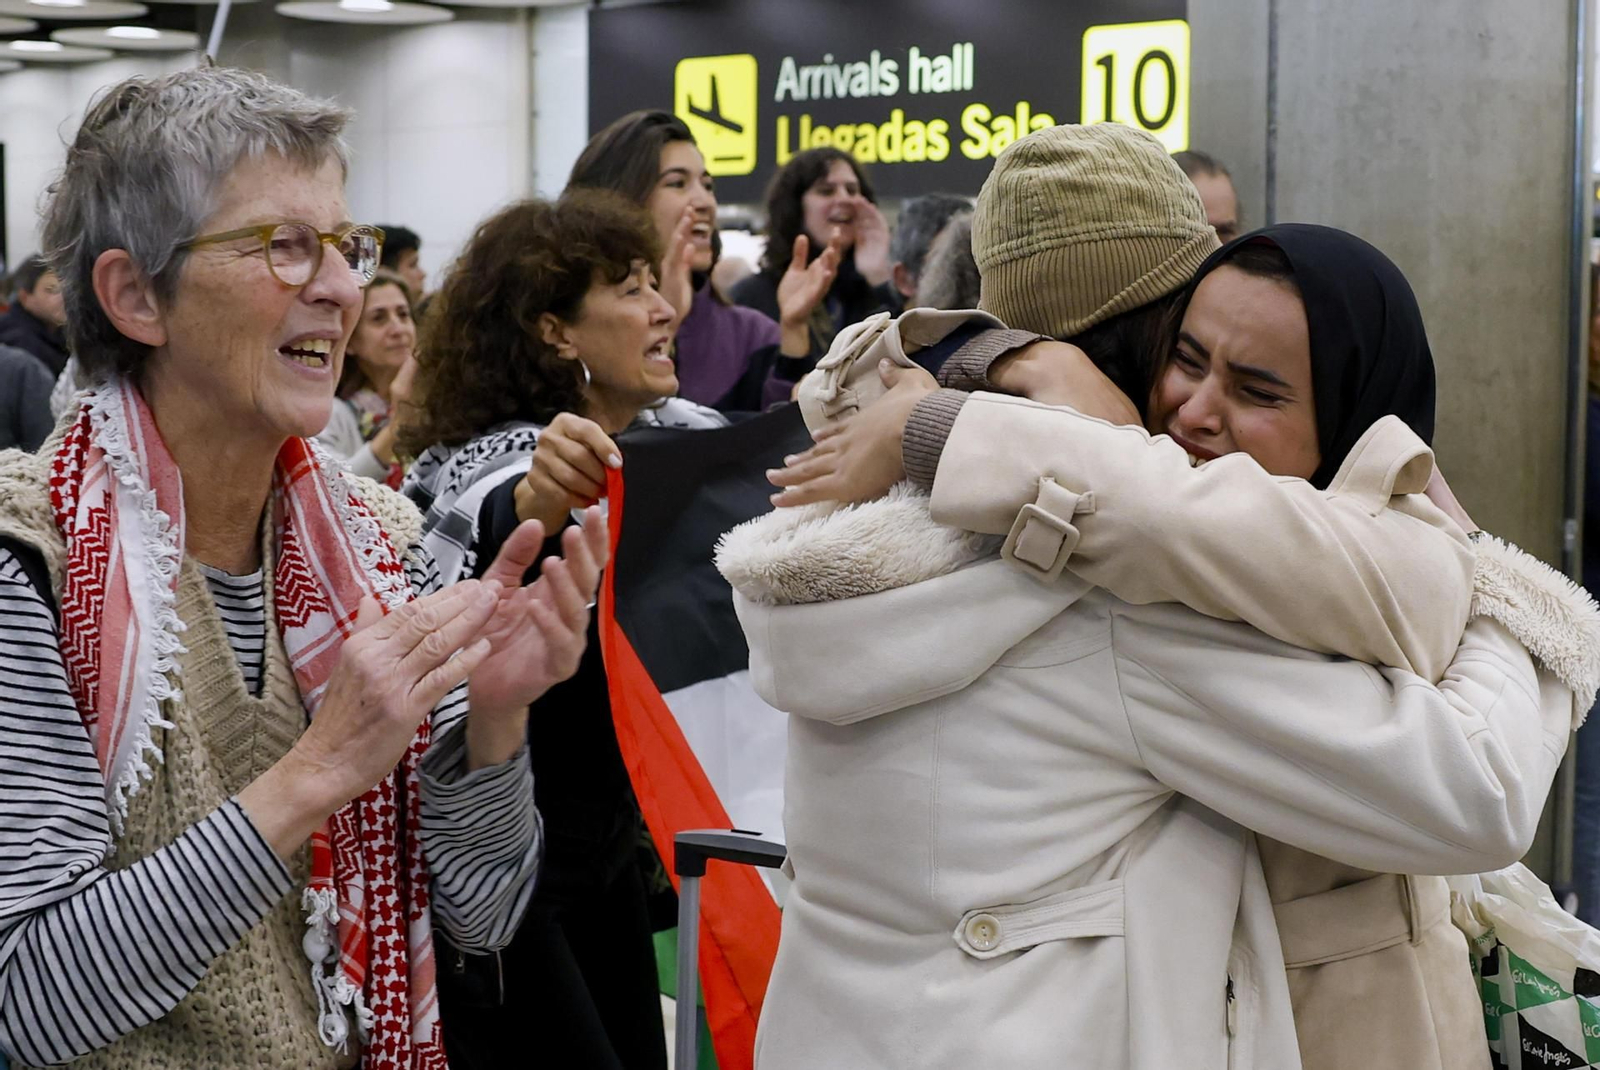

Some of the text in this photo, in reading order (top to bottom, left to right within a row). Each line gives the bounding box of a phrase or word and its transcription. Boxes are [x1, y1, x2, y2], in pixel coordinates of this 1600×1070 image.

[775, 42, 974, 102] Arrivals hall
[1096, 49, 1176, 130] 10
